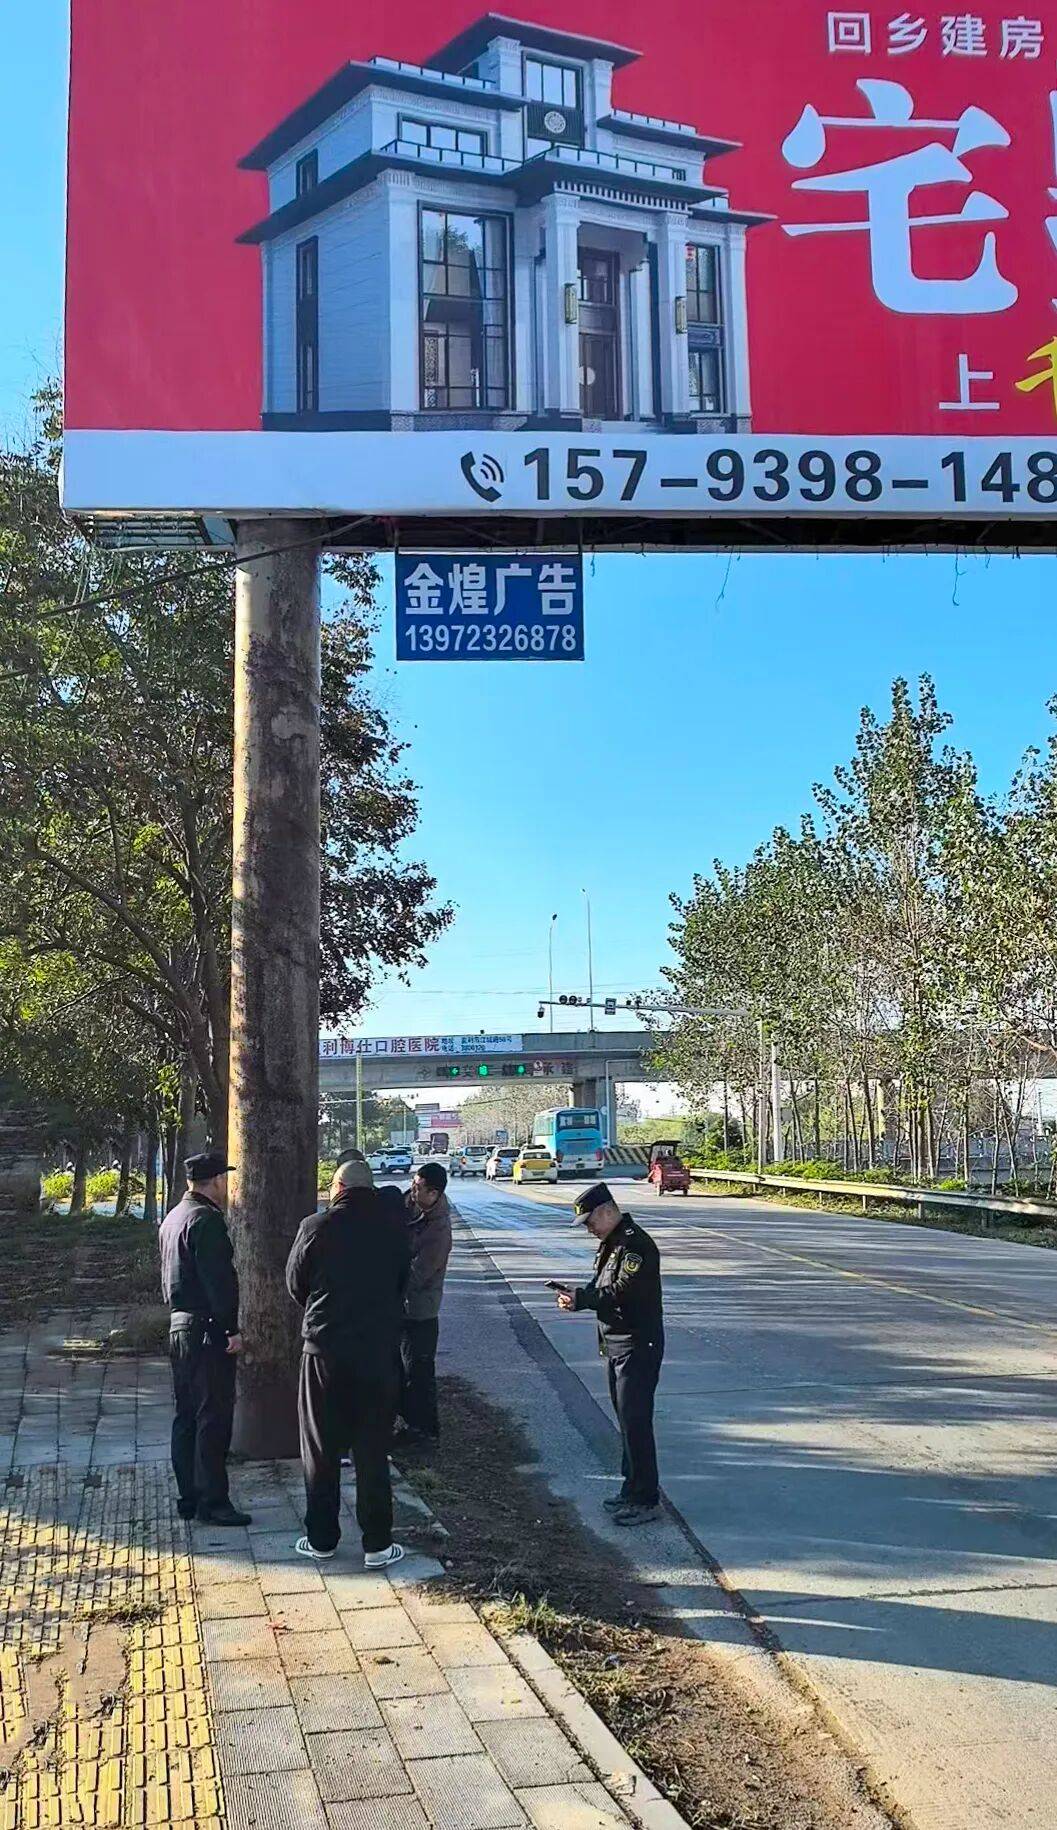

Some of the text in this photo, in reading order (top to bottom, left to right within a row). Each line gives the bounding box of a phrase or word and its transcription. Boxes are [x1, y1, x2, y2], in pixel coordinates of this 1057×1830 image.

[827, 11, 1045, 59] 回乡建房
[781, 78, 1057, 314] 宅
[403, 563, 577, 616] 金煌广告
[405, 624, 577, 651] 13972326878
